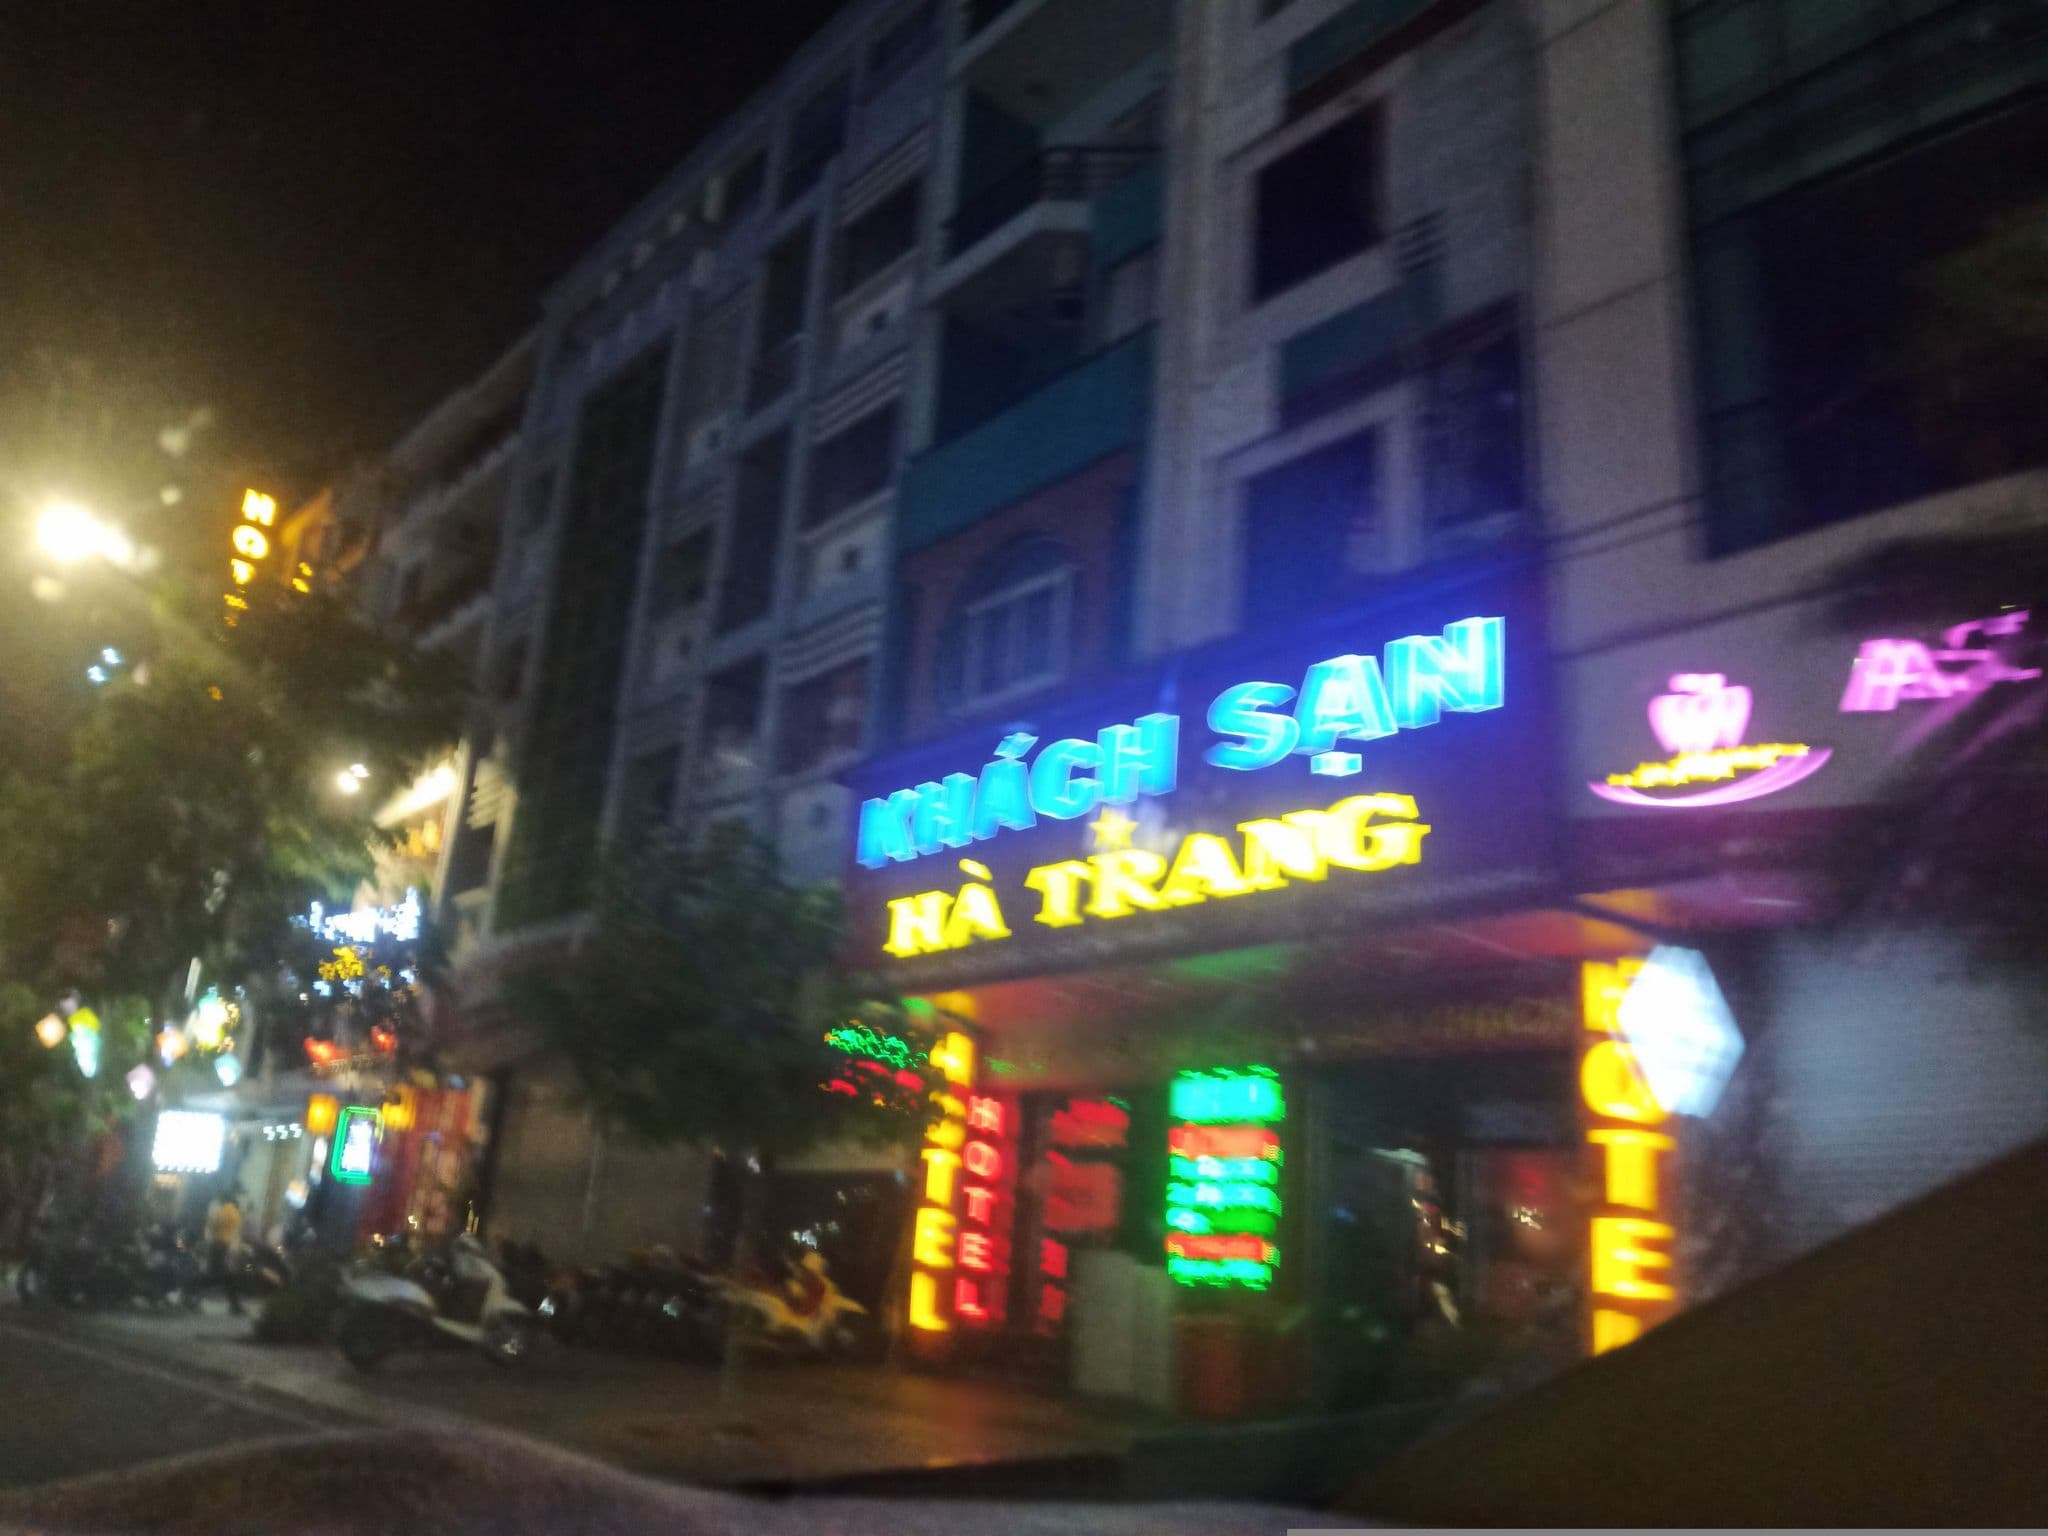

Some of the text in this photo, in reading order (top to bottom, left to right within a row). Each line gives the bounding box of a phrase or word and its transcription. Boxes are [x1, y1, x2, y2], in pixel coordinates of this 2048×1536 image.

[856, 616, 1506, 870] KHÁCH SẠN
[883, 792, 1431, 958] HÀ TRANG
[954, 1095, 1006, 1322] HOTEL
